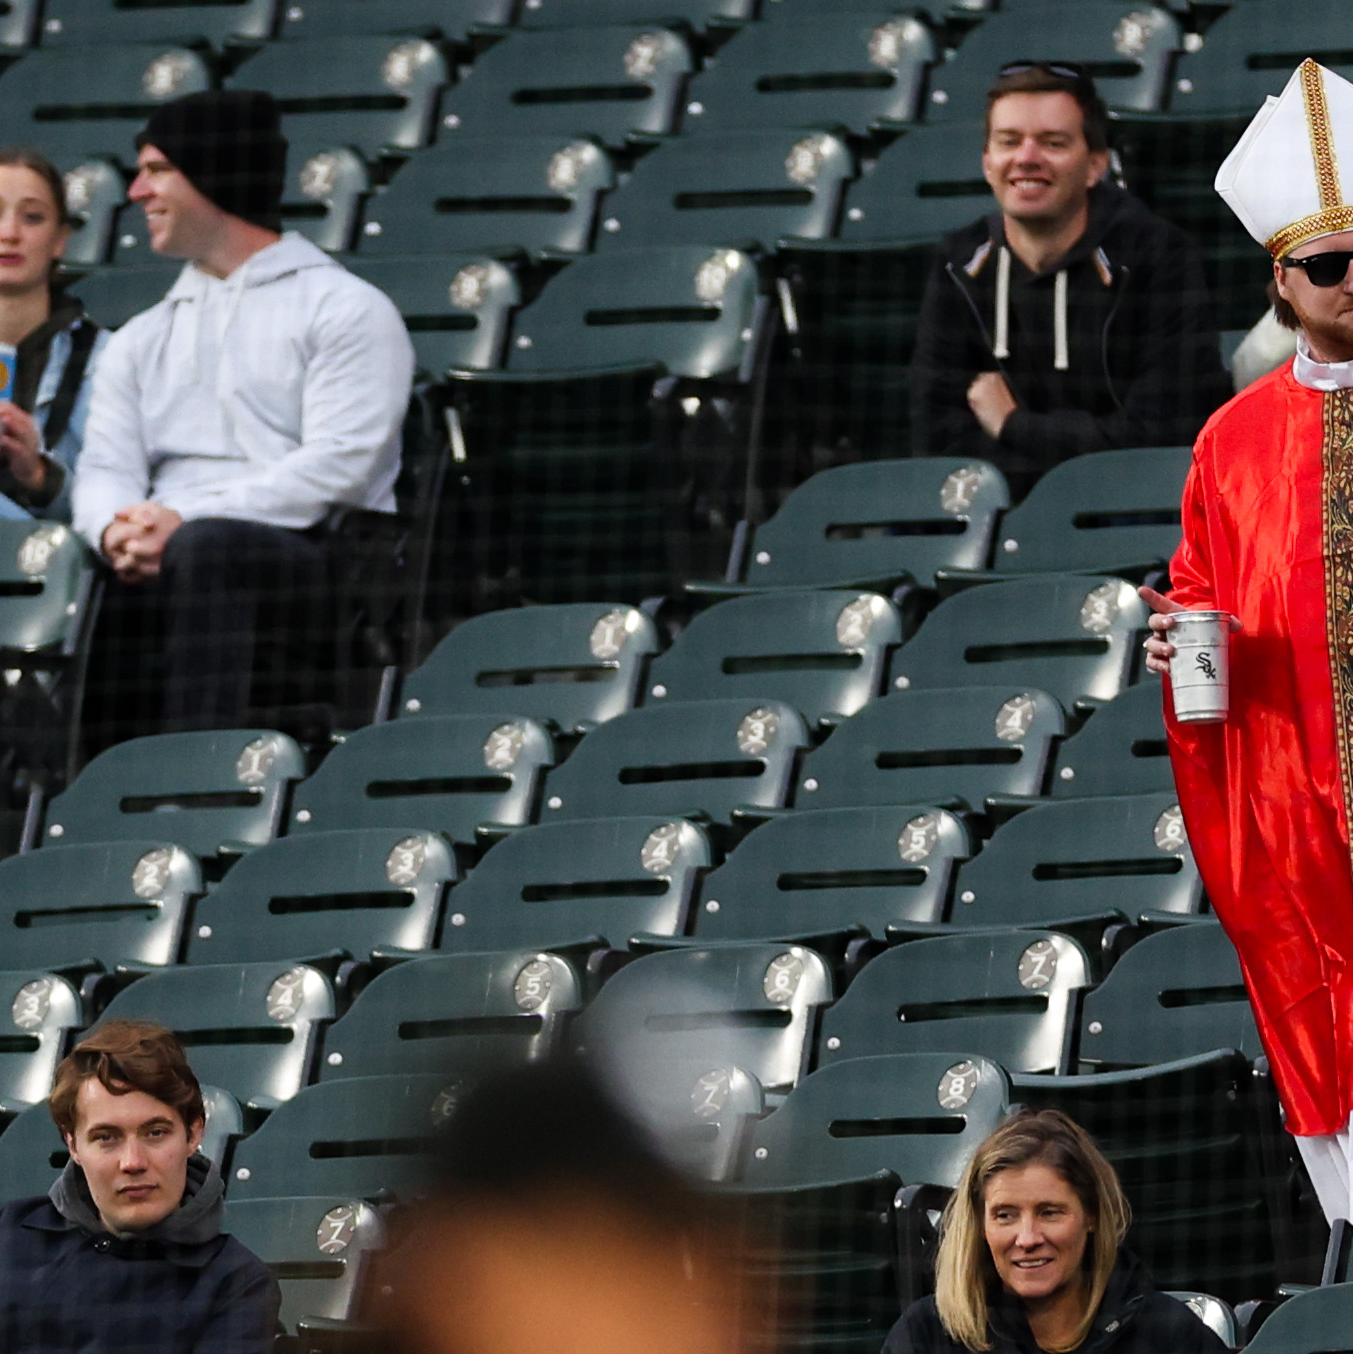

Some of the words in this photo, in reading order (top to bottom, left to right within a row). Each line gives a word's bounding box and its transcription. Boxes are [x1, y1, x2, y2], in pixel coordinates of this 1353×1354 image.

[1092, 600, 1106, 621] 3
[848, 614, 861, 634] 2
[1195, 652, 1216, 679] Sox
[1006, 711, 1021, 729] 4
[749, 722, 764, 742] 3
[1167, 818, 1180, 836] 6
[910, 830, 925, 848] 5
[653, 840, 666, 858] 4
[400, 852, 414, 872] 3
[1032, 956, 1046, 974] 7
[527, 977, 540, 994] 5
[776, 969, 788, 990] 6
[278, 984, 292, 1006] 4
[25, 996, 38, 1015] 3
[705, 1083, 718, 1103] 7
[950, 1078, 964, 1097] 8
[330, 1222, 344, 1240] 7
